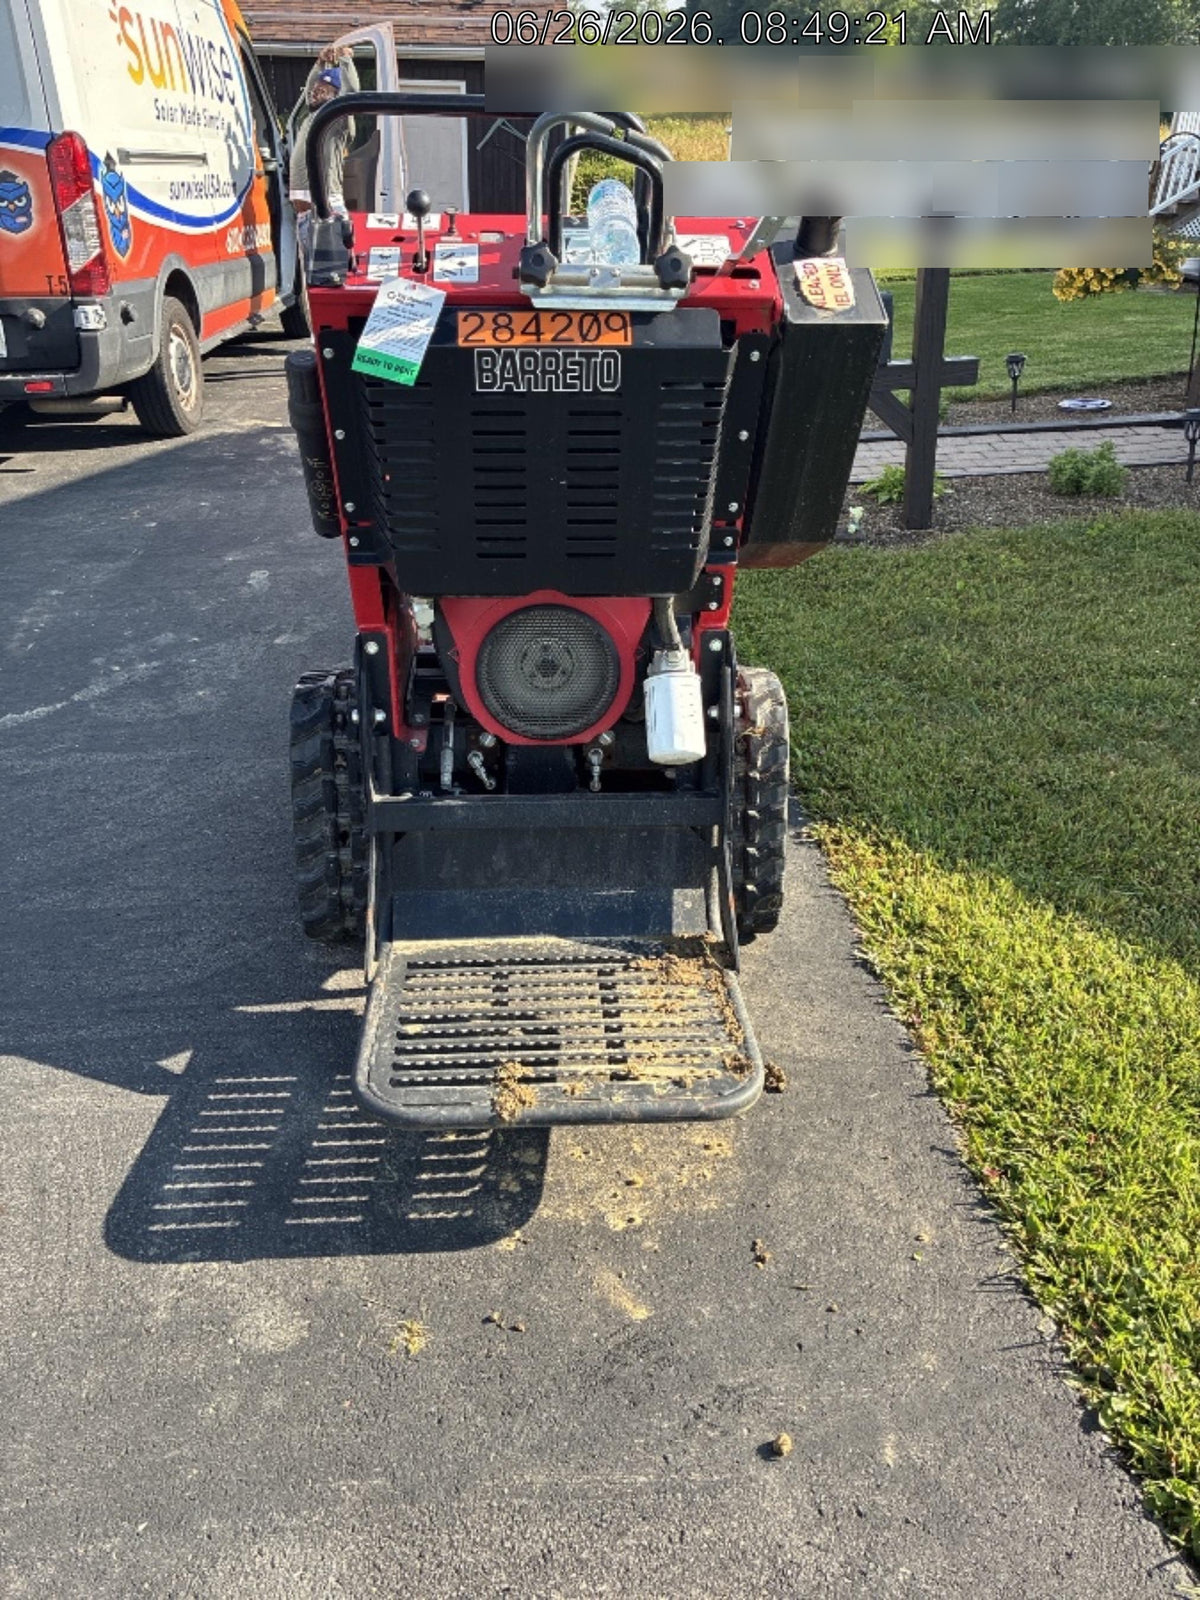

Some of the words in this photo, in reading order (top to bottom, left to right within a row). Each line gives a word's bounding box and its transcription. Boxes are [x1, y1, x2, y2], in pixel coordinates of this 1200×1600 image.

[154, 98, 179, 123] Solar
[179, 102, 202, 127] Made
[169, 172, 238, 200] sunwiseUSA.com
[45, 274, 68, 295] T-5
[461, 312, 630, 343] 284209
[474, 348, 622, 392] BARRETO
